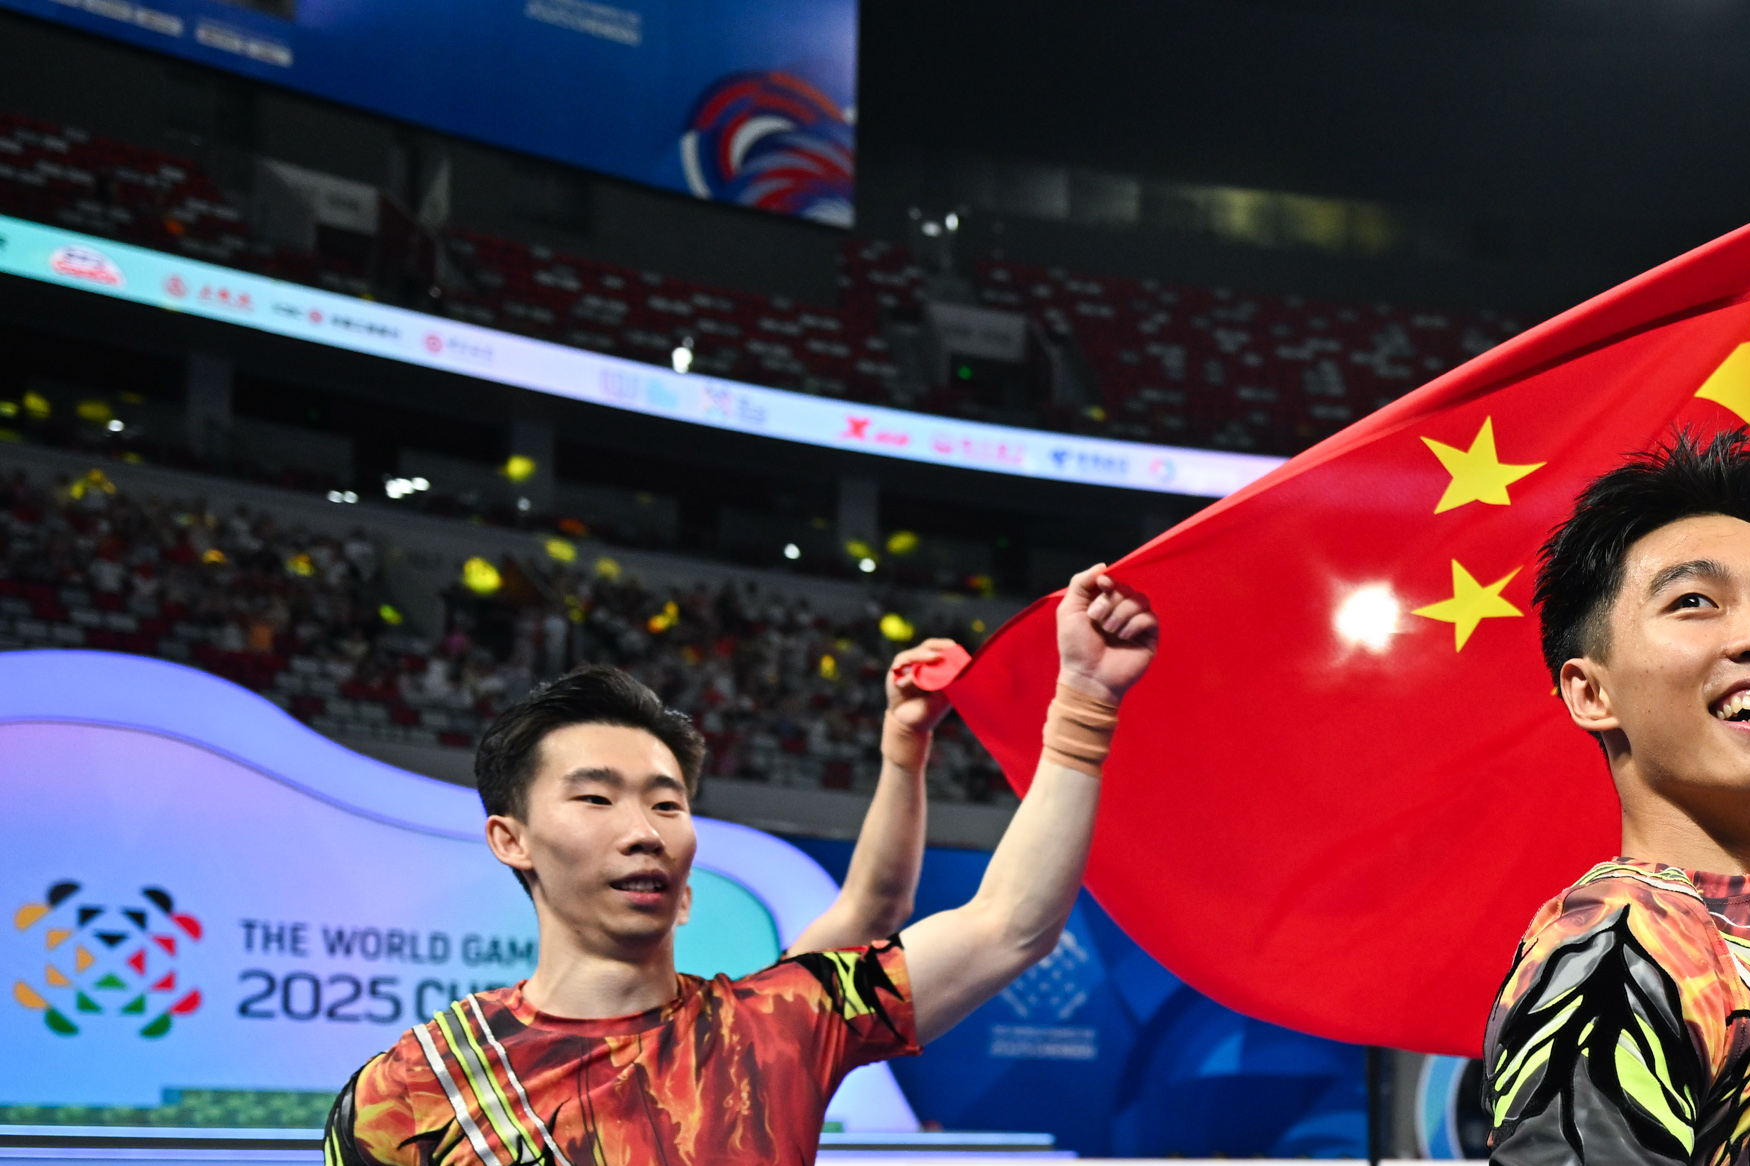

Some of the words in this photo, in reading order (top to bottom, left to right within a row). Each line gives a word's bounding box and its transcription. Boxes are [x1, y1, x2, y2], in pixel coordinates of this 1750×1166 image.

[239, 918, 309, 957] THE
[321, 925, 451, 965] WORLD
[461, 932, 539, 968] GAM
[237, 968, 404, 1024] 2025
